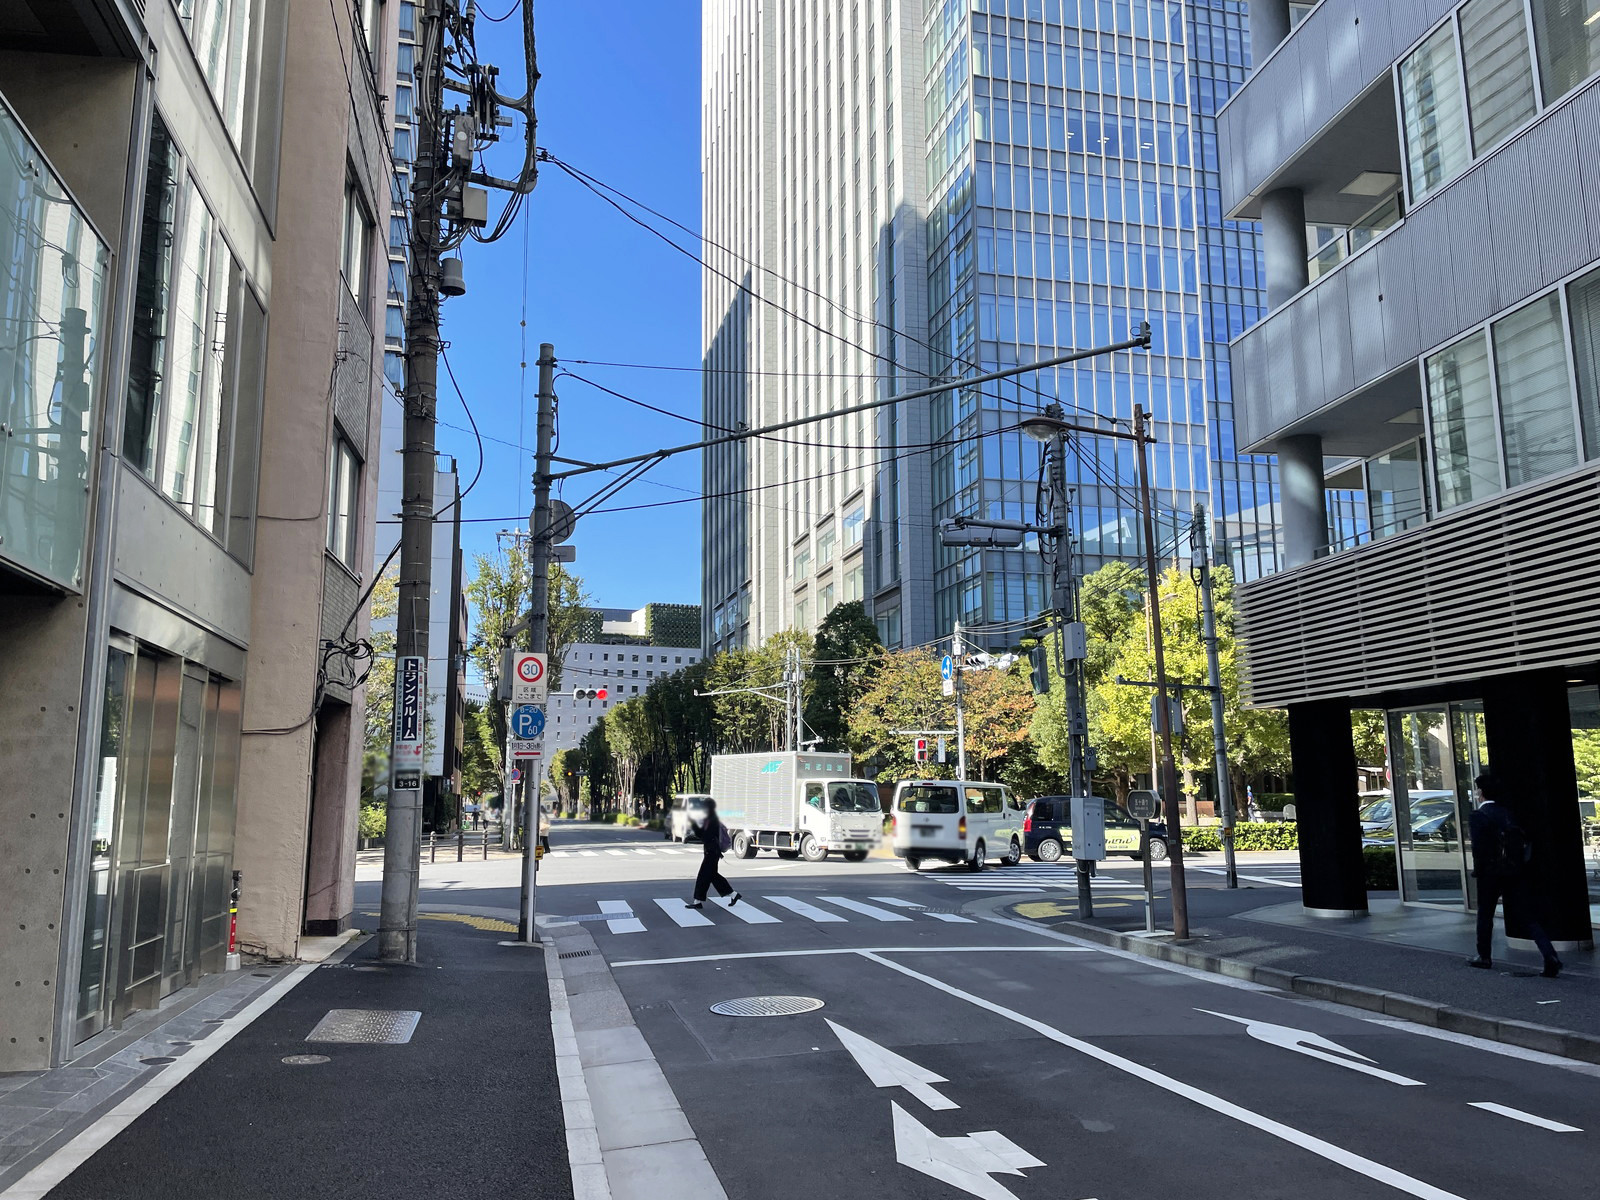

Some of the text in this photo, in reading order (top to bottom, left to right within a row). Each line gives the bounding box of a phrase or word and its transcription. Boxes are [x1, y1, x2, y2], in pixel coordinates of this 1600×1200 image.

[523, 663, 538, 676] 30
[403, 660, 416, 739] トランクルーム
[519, 714, 533, 735] P
[399, 780, 417, 788] 3-16
